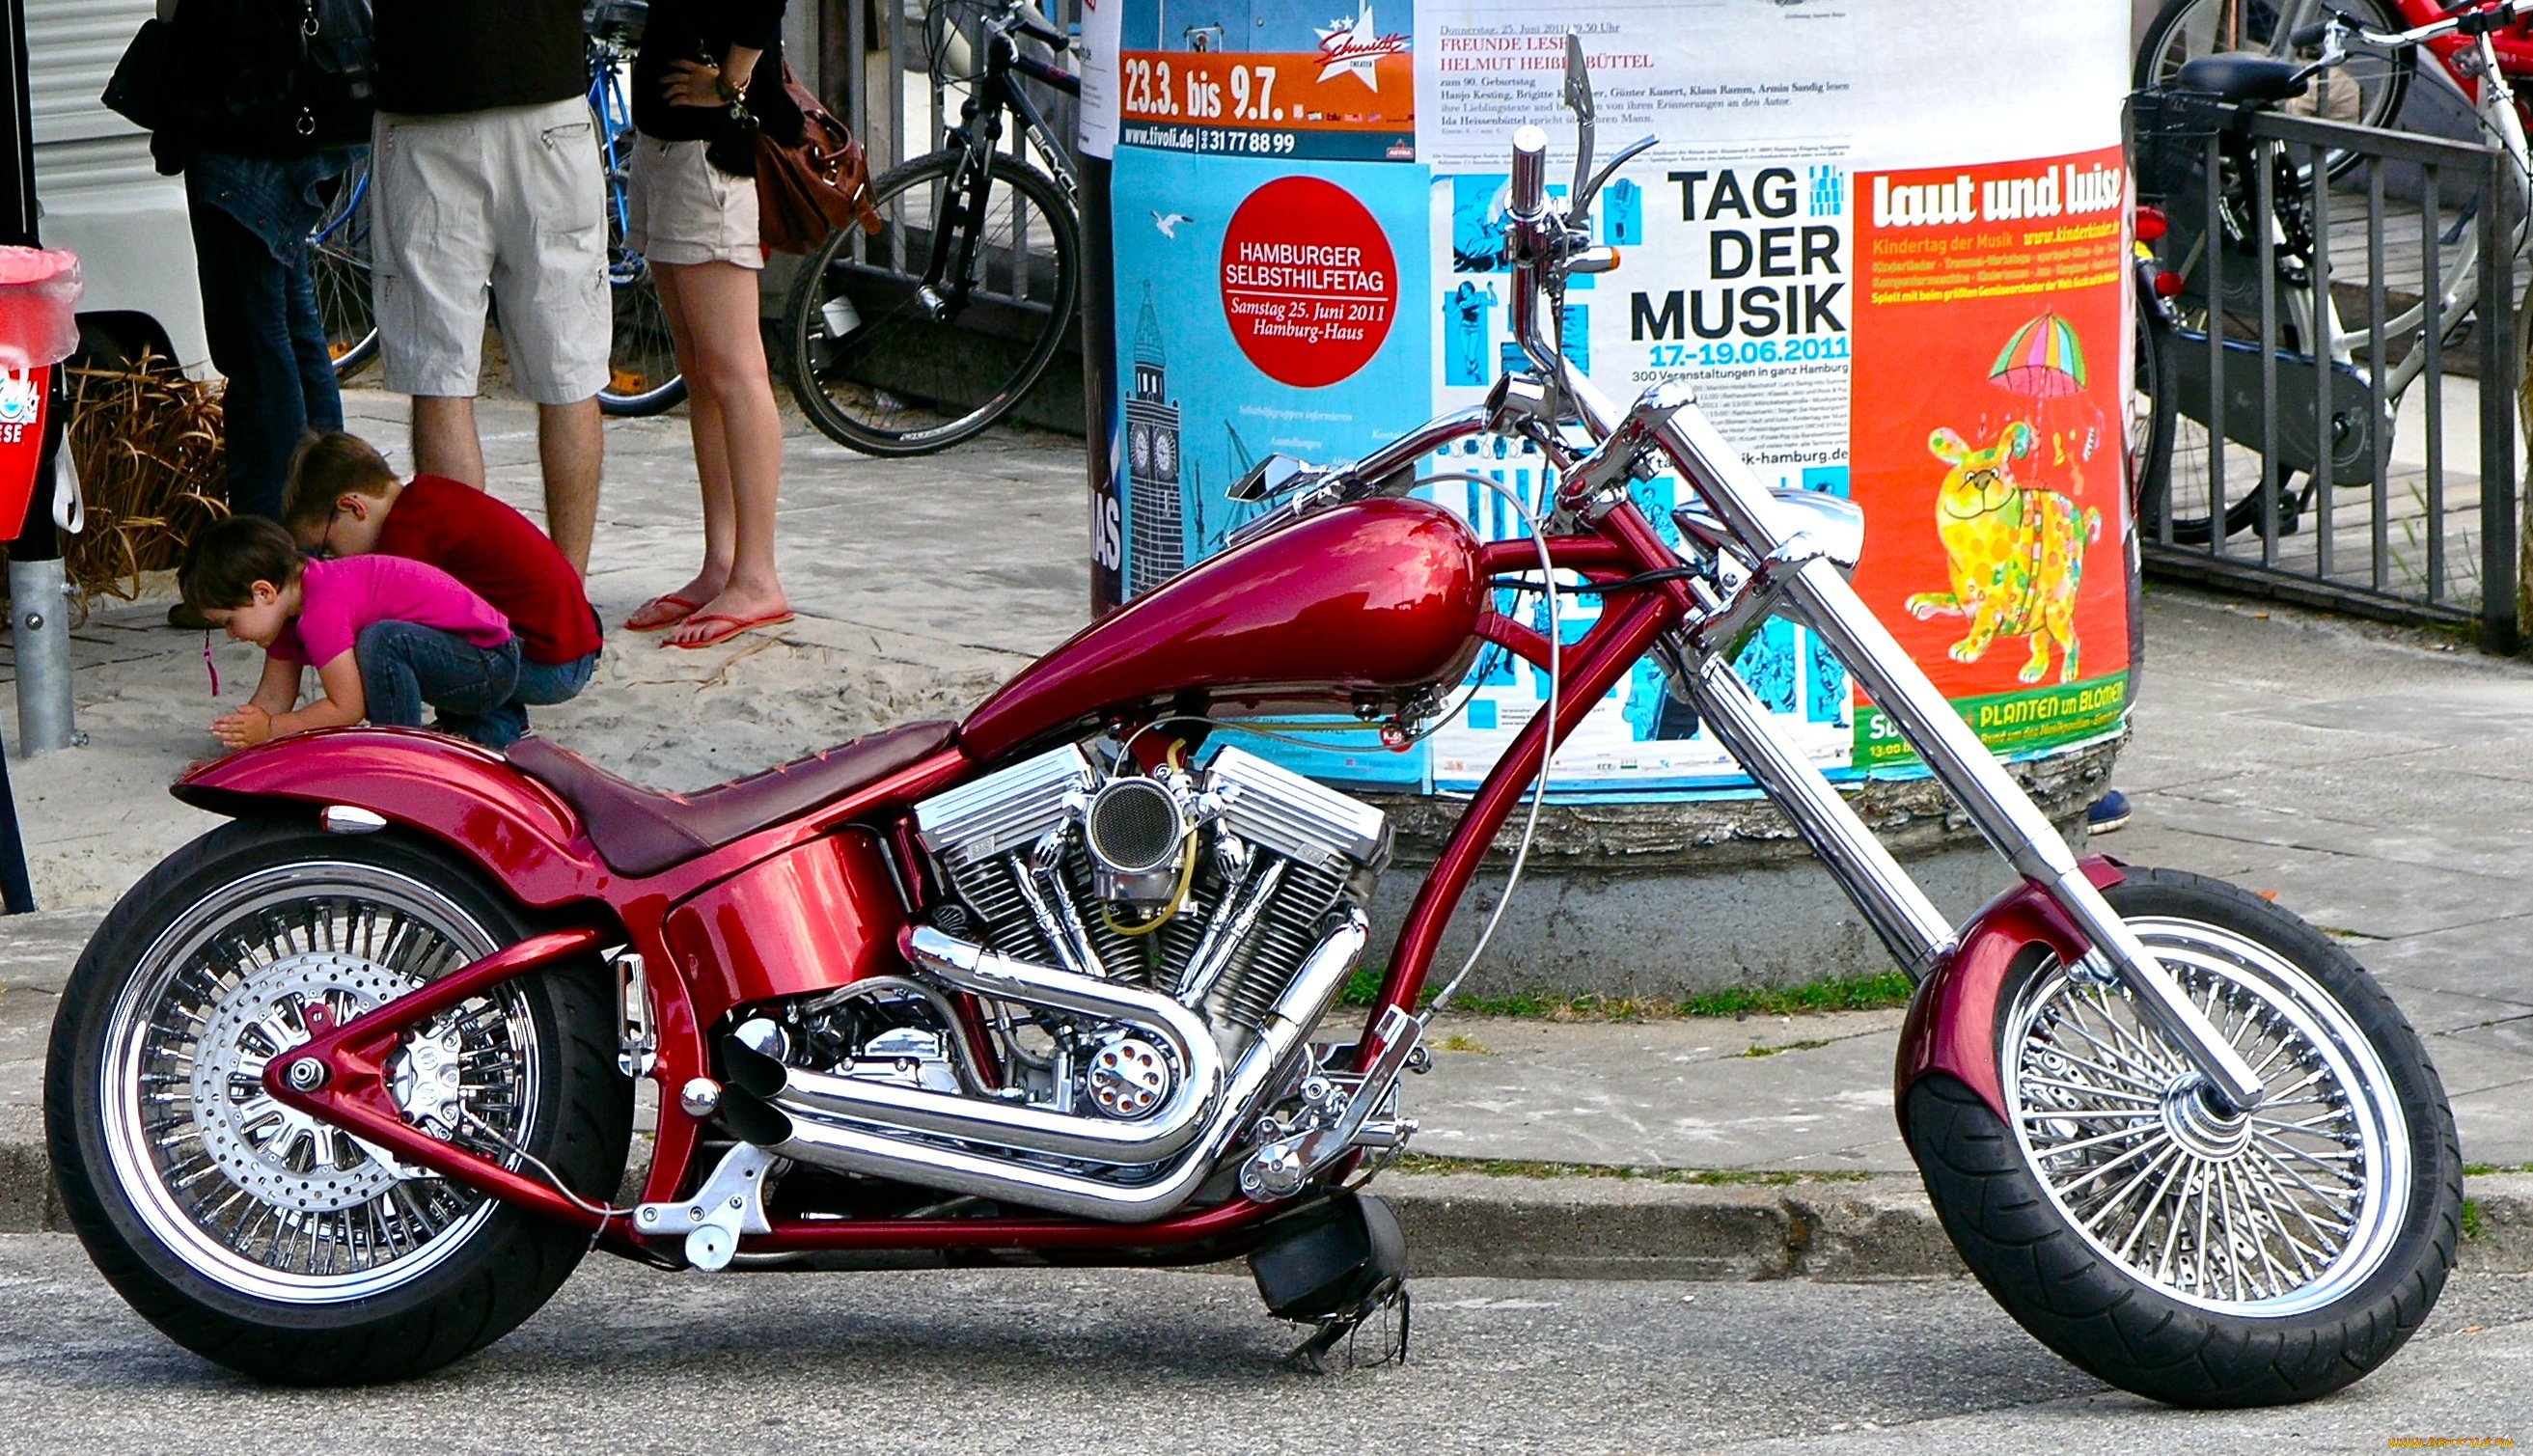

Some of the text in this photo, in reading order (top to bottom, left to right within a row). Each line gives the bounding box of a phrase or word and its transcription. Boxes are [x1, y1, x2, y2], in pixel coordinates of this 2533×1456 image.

[1600, 22, 1620, 34] Uhr
[1440, 37, 1569, 52] FREUNDE LESE
[1440, 52, 1654, 71] HELMUT HEIßEBÜTTEL
[1125, 58, 1179, 116] 23.3.
[1187, 69, 1222, 119] bis
[1230, 65, 1283, 122] 9.7.
[1481, 77, 1536, 88] Geburtstag
[1611, 87, 1645, 97] Günter
[1690, 86, 1718, 96] Klaus
[1758, 84, 1789, 94] Armin
[1792, 82, 1824, 95] Sandig
[1441, 91, 1471, 101] Hanjo
[1517, 90, 1554, 100] Brigitte
[1627, 100, 1654, 110] ihren
[1657, 99, 1724, 110] Erinnerungen
[1742, 97, 1760, 107] den
[1441, 103, 1460, 113] ihre
[1464, 102, 1531, 114] Lieblingstexte
[1534, 102, 1554, 112] und
[1621, 114, 1654, 123] Mann.
[1442, 116, 1457, 125] Ida
[1529, 116, 1563, 126] spricht
[1125, 125, 1195, 150] www.tivoli.de
[1667, 167, 1797, 221] TAG
[1873, 162, 2122, 229] laut und luise
[1240, 241, 1362, 267] HAMBURGER
[1710, 225, 1841, 280] DER
[1873, 232, 2013, 255] Kindertag der Musik
[1225, 263, 1384, 292] SELBSTHILFETAG
[1230, 297, 1385, 322] Samstag 25. Juni 2011
[1631, 282, 1847, 341] MUSIK
[1253, 318, 1364, 343] Hamburg-Haus
[1650, 336, 1850, 368] 17.-19.06.2011
[1632, 363, 1849, 382] 300 Veranstaltungen in ganz Hamburg
[0, 424, 22, 443] SE
[1741, 448, 1849, 466] ik-hamburg.de
[1092, 488, 1121, 571] AS
[1980, 697, 2059, 728] PLANTEN
[2062, 698, 2077, 715] un
[2079, 681, 2124, 712] BLOMEN
